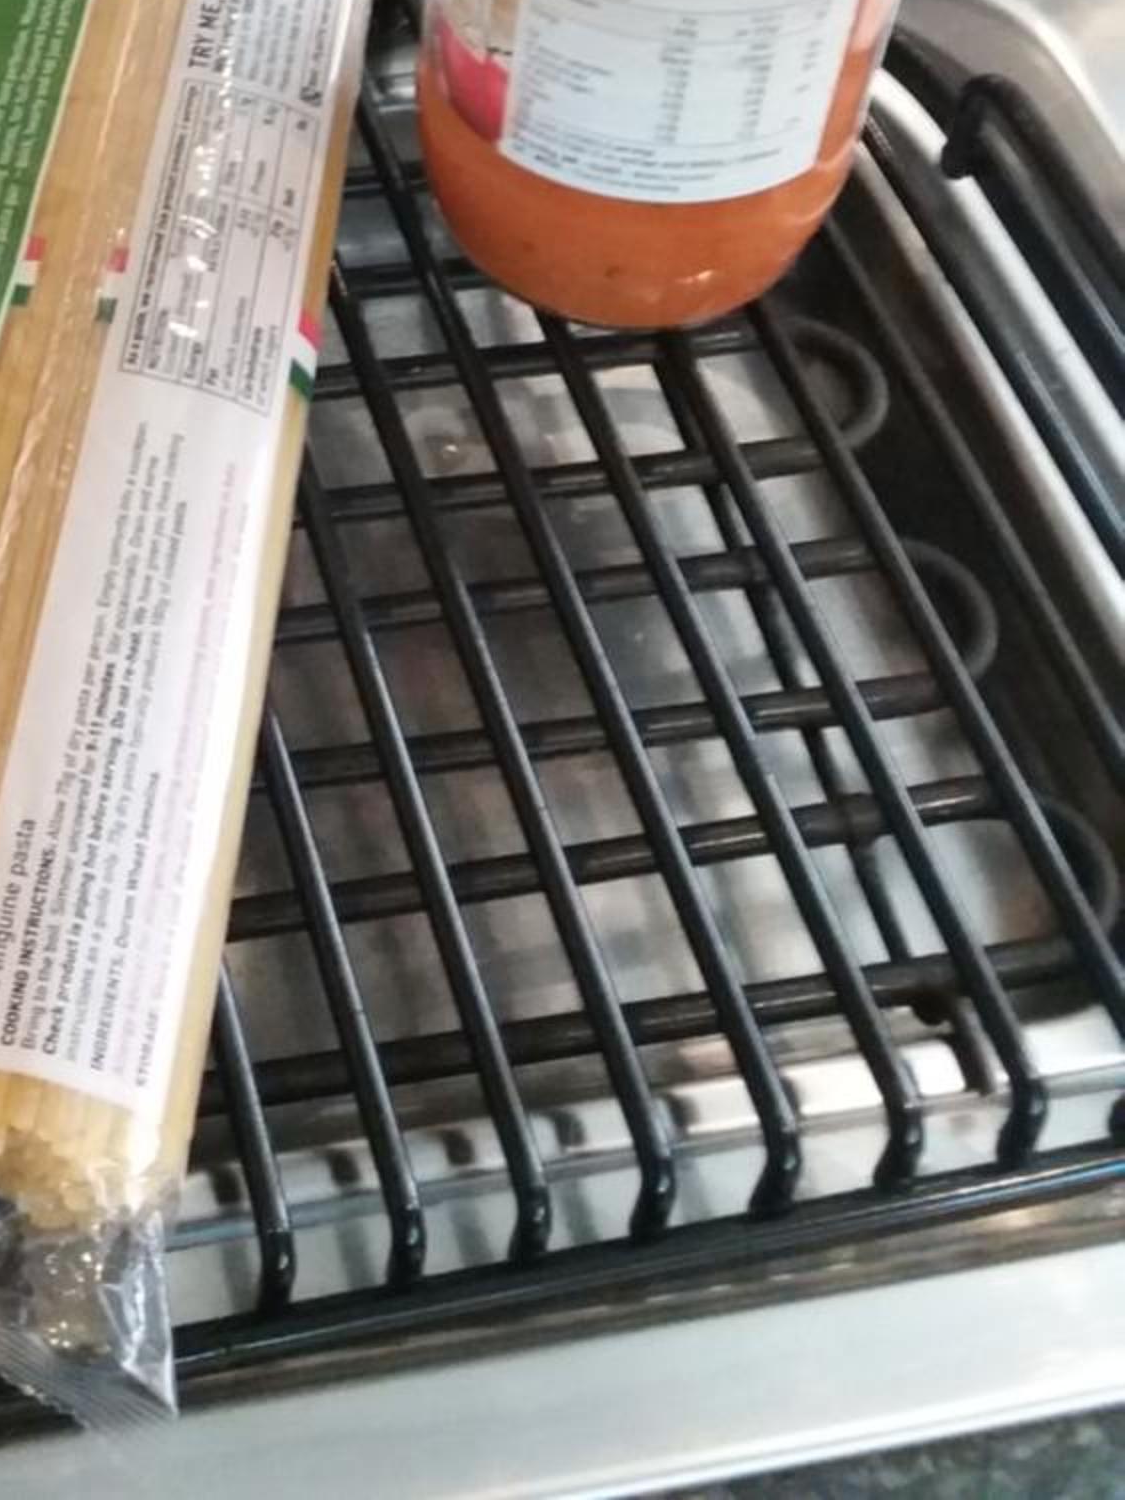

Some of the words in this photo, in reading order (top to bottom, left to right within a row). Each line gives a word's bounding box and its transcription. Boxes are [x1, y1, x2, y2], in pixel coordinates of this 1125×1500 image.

[187, 34, 216, 68] TRY
[110, 709, 126, 728] Do
[116, 685, 132, 706] not
[64, 778, 92, 853] uncovered
[86, 792, 109, 840] before
[6, 817, 40, 877] pasta
[80, 843, 99, 868] hot
[124, 842, 146, 890] Wheat
[49, 855, 75, 916] Simmer
[71, 871, 96, 919] piping
[0, 969, 30, 1046] COOKING
[46, 800, 67, 840] Allow
[67, 921, 83, 936] is
[35, 954, 54, 981] the
[54, 939, 82, 1002] product
[31, 984, 48, 1001] to
[20, 1005, 46, 1050] Bring
[41, 1004, 65, 1055] Check
